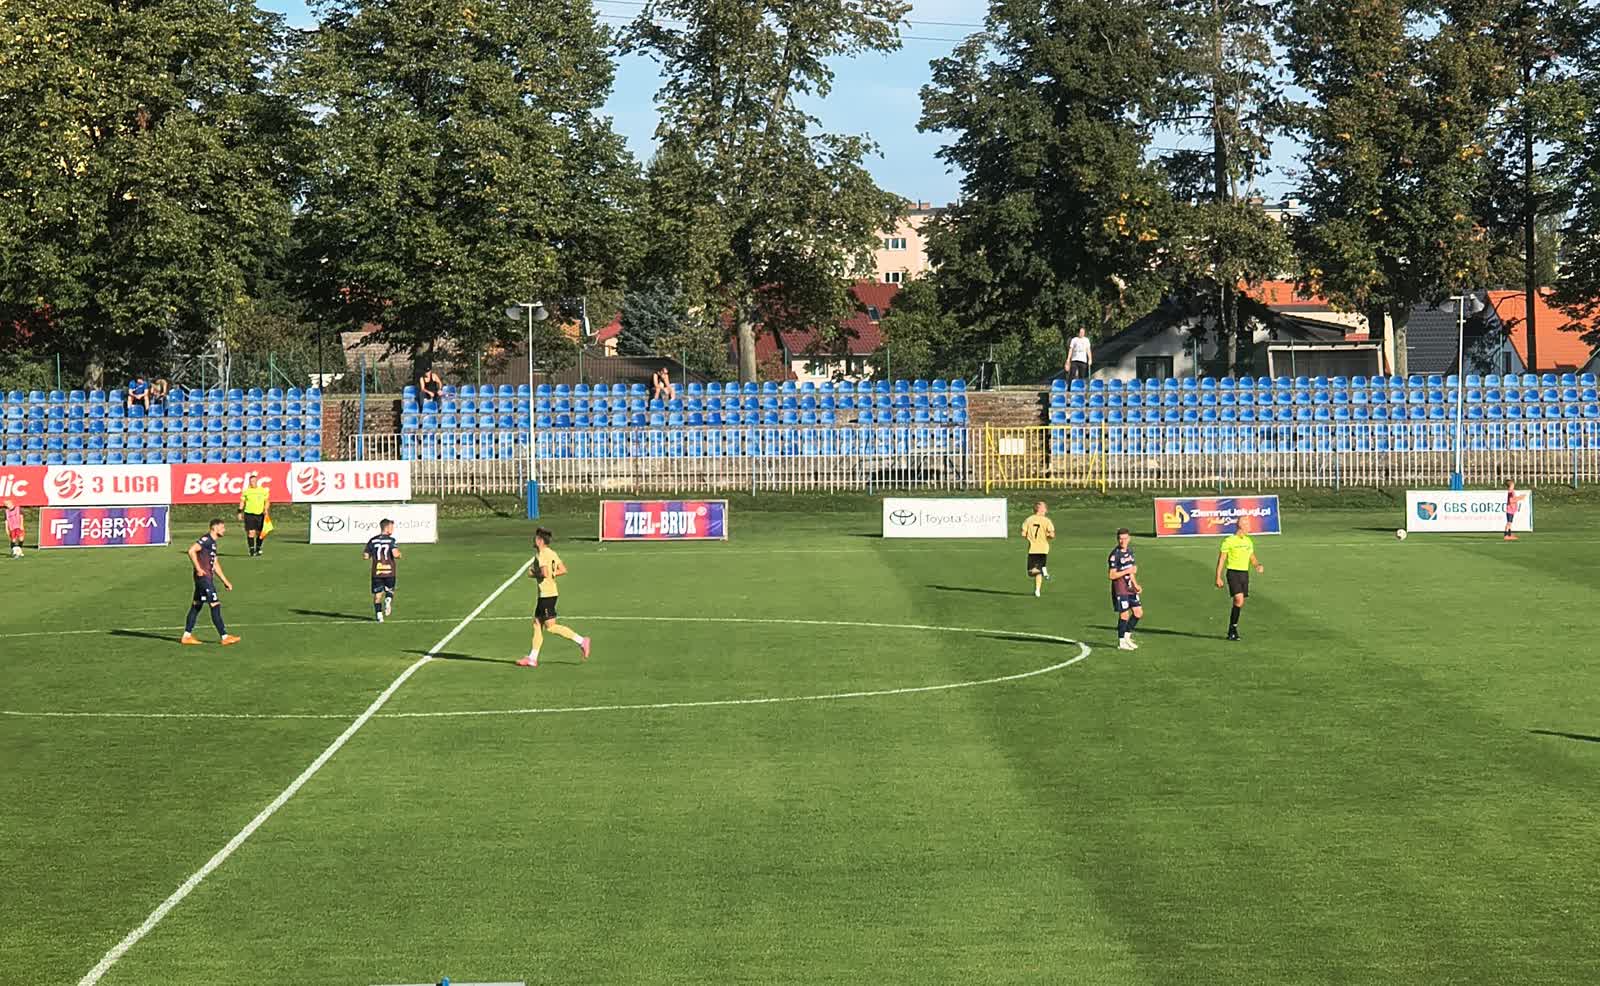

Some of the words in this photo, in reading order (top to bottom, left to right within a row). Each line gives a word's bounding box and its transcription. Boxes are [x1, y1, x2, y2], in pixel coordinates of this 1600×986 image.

[92, 476, 104, 493] 3
[113, 475, 159, 493] LIGA
[334, 473, 345, 489] 3
[354, 471, 399, 490] LIGA
[1444, 502, 1467, 513] GBS
[1471, 502, 1522, 513] GORZ
[80, 517, 158, 529] FABRYKA
[624, 511, 697, 535] ZIEL-BRUK
[80, 528, 137, 540] FORMY
[1033, 524, 1040, 539] 7
[374, 543, 389, 560] 77
